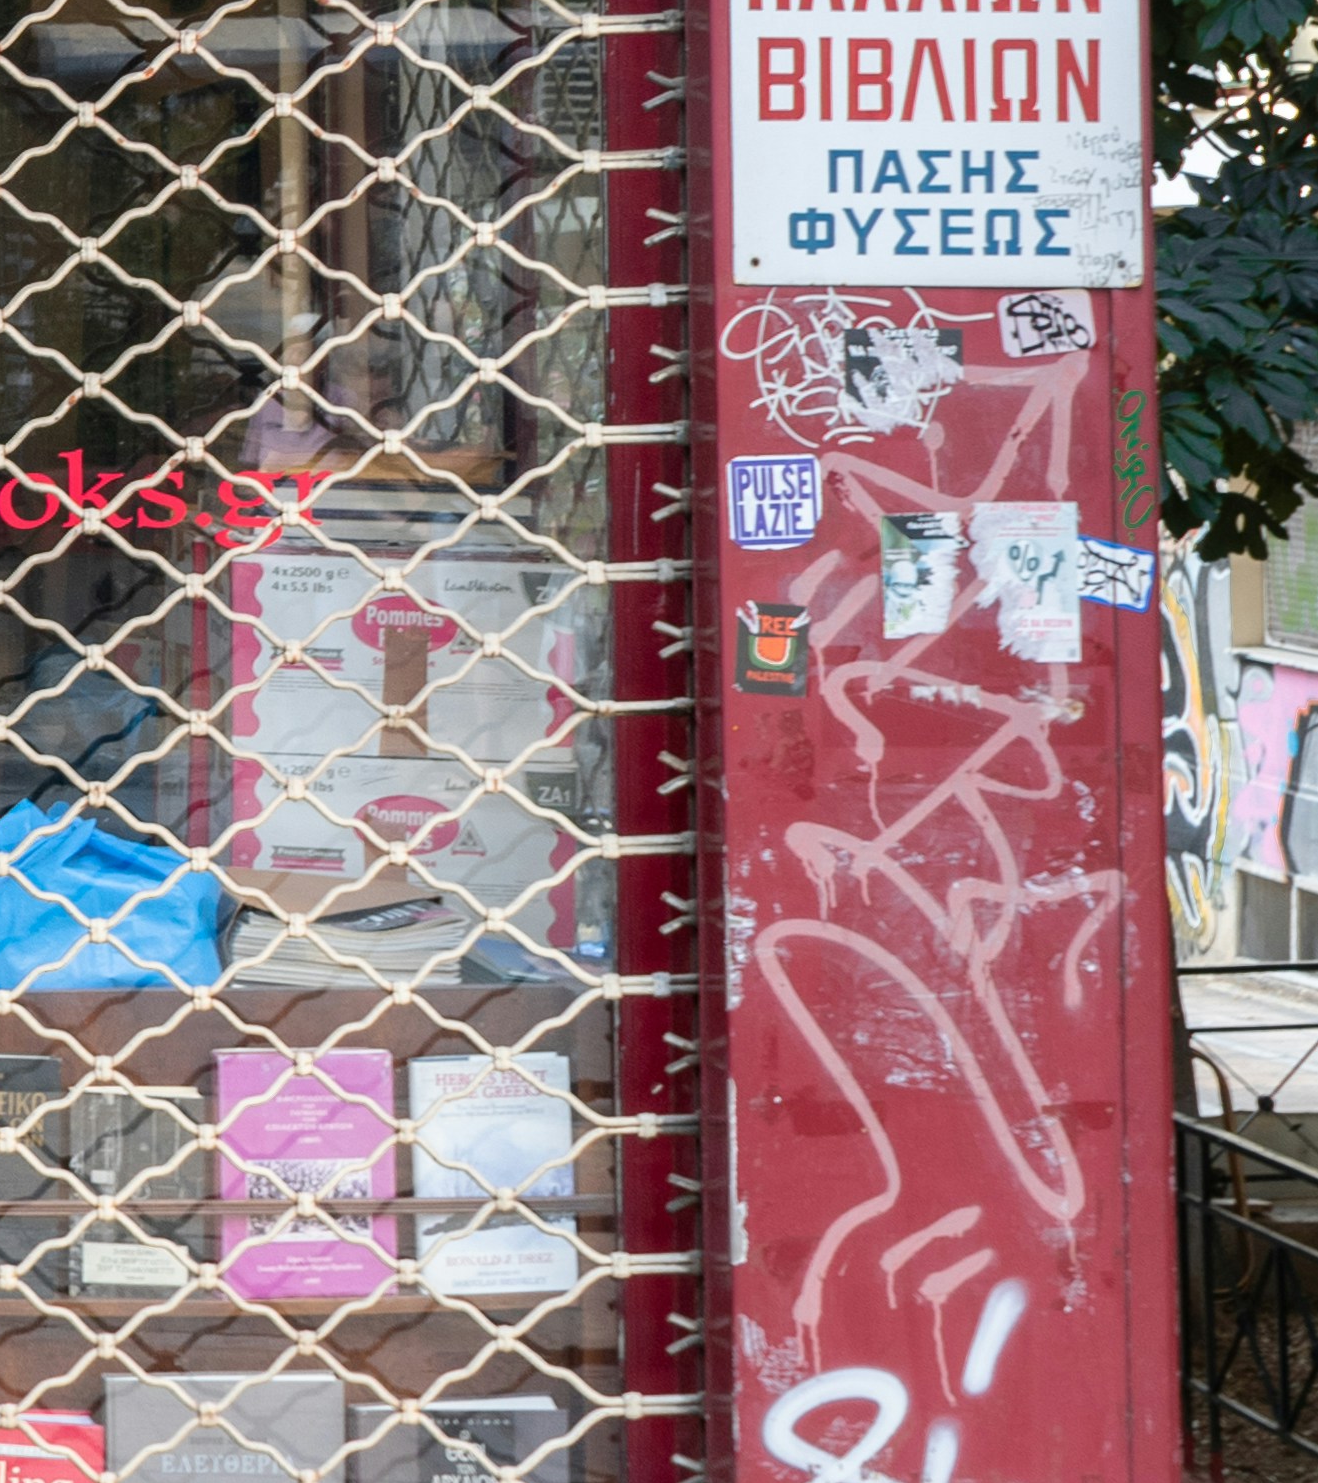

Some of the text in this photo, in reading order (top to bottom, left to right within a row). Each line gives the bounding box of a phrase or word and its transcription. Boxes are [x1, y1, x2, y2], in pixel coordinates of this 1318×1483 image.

[758, 36, 1101, 123] ΒΙΒΛΙΩΝ
[827, 149, 1040, 194] ΠΑΣΗΣ
[788, 207, 1072, 257] ΦΥΣΕΩΣ
[735, 465, 811, 501] PULSE
[736, 501, 803, 537] LAZIE
[312, 580, 334, 594] lbs
